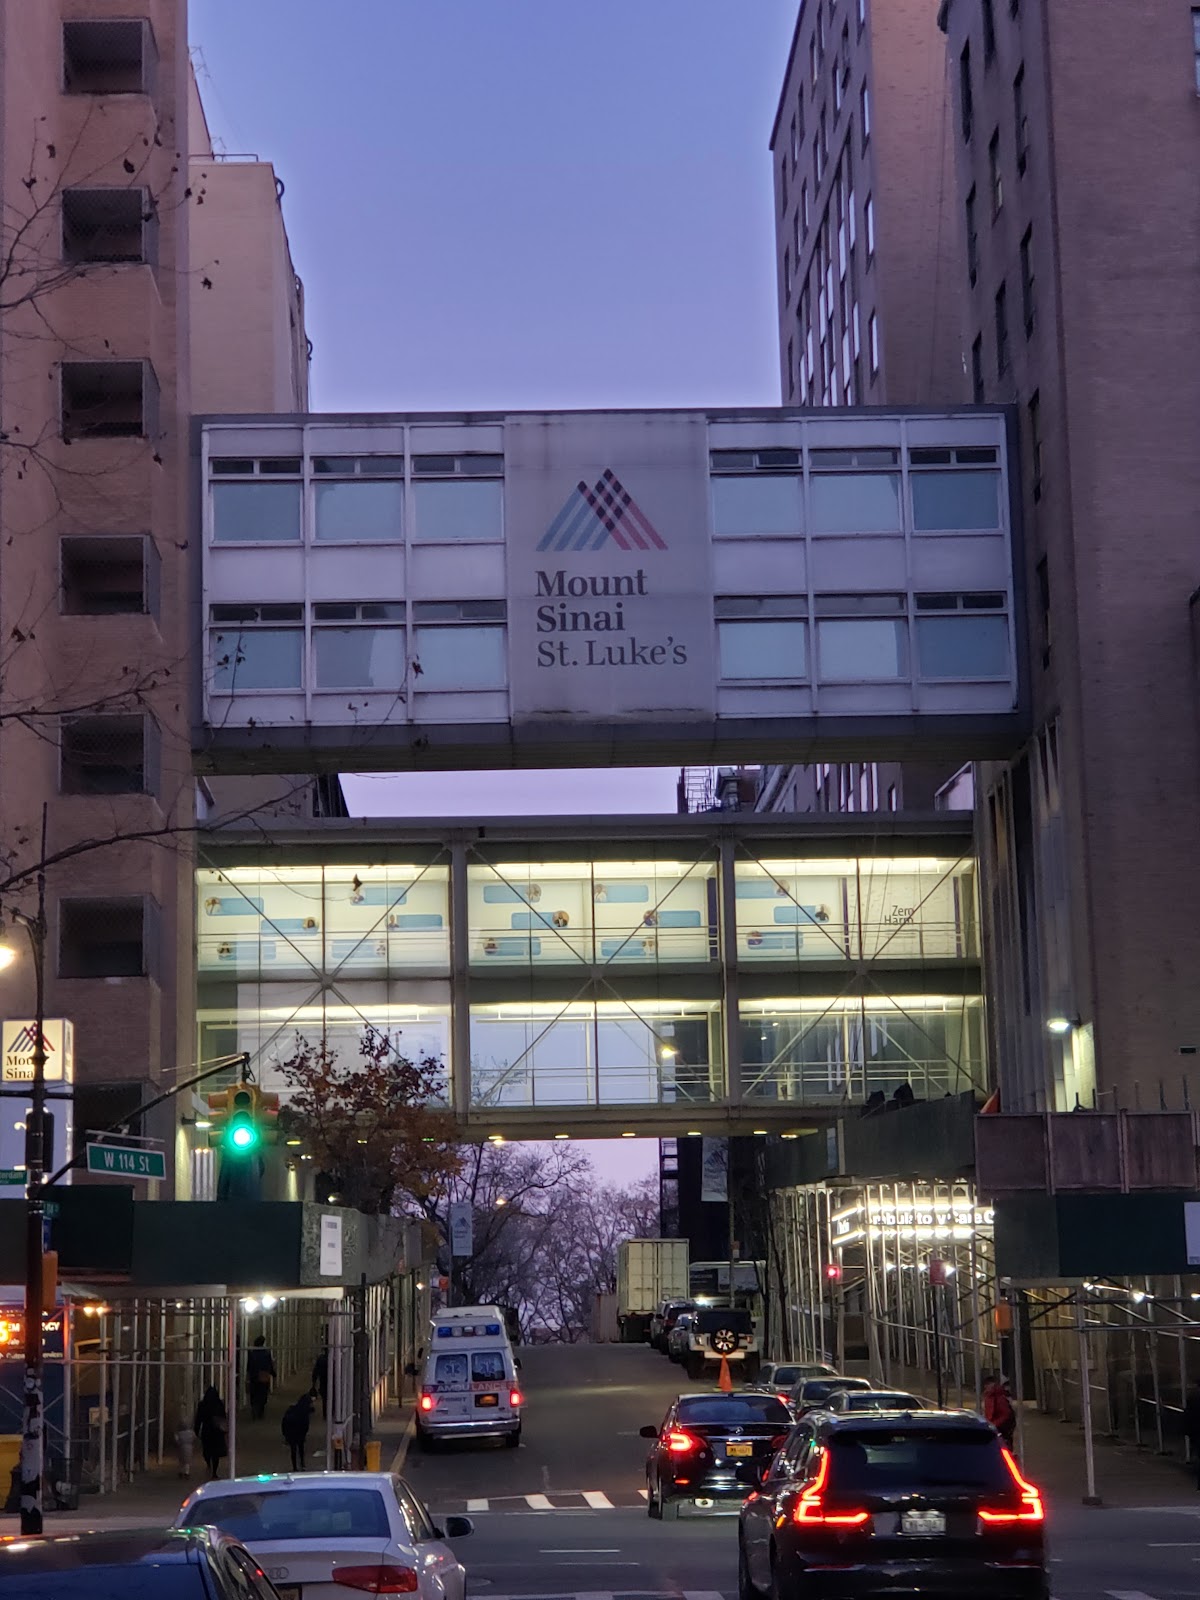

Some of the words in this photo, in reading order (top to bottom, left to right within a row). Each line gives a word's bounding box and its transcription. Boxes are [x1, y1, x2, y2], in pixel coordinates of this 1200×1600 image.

[535, 569, 648, 597] Mount
[537, 602, 626, 632] Sinai
[537, 640, 578, 667] St.
[585, 636, 687, 666] Luke's
[892, 905, 914, 916] Zero
[7, 1055, 34, 1066] Mou
[6, 1068, 34, 1079] Sina
[104, 1151, 114, 1168] W
[119, 1153, 135, 1170] 114
[139, 1155, 150, 1173] St
[437, 1382, 507, 1392] AMBULANCE
